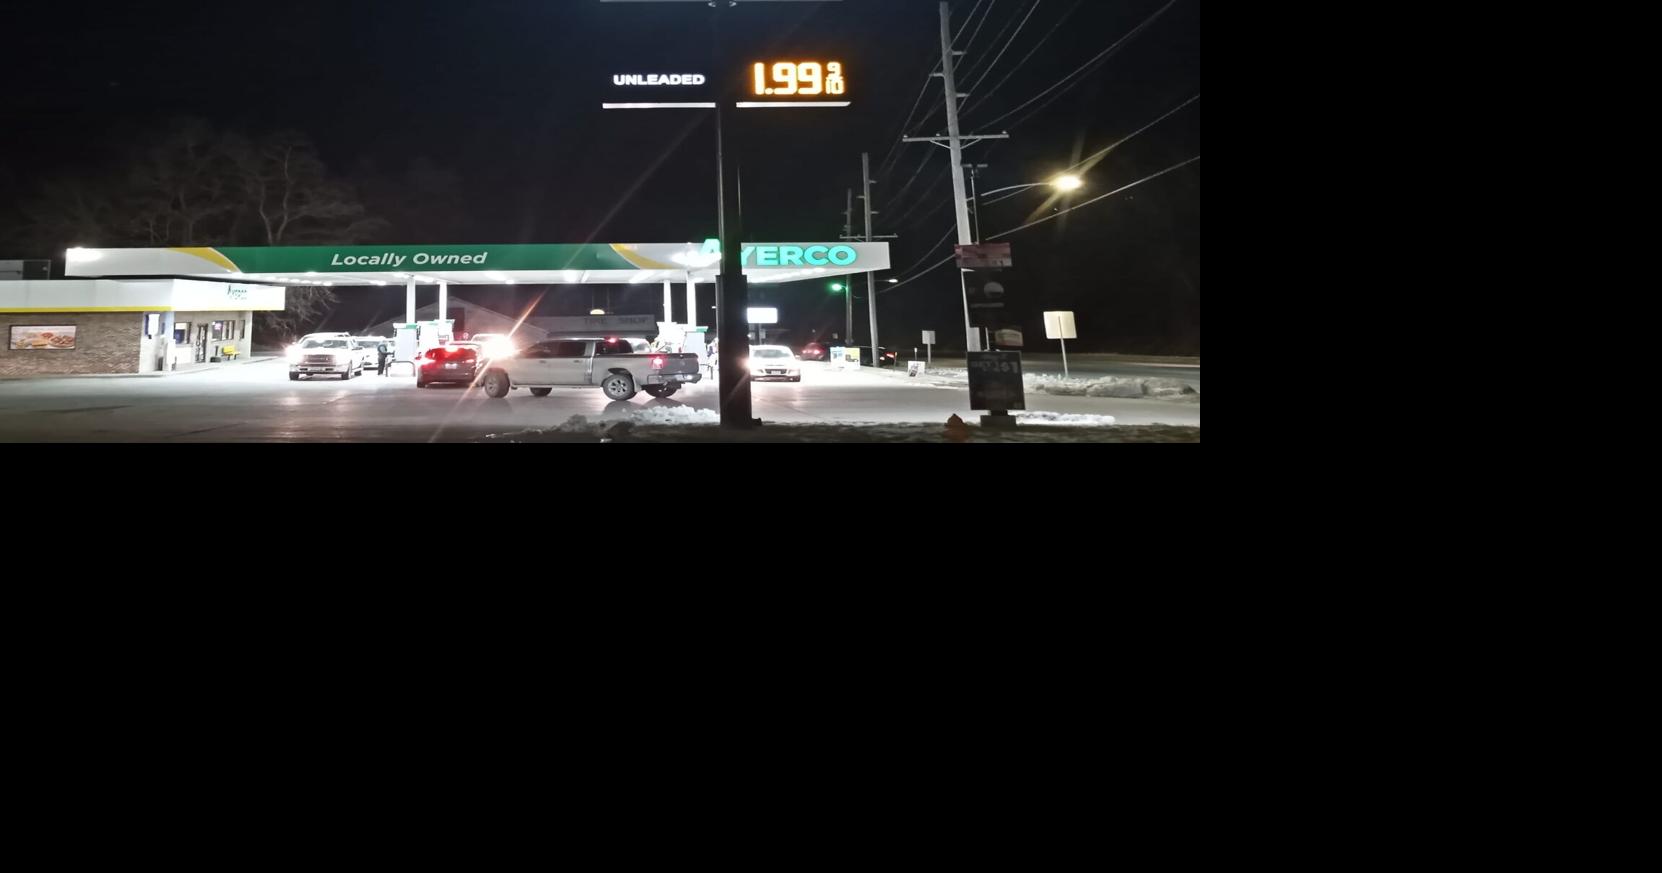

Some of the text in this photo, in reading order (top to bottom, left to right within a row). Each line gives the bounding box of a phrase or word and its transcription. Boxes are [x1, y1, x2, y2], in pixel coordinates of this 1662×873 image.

[613, 74, 706, 86] UNLEADED
[754, 62, 822, 95] 1.99
[331, 251, 488, 267] Locally Owned
